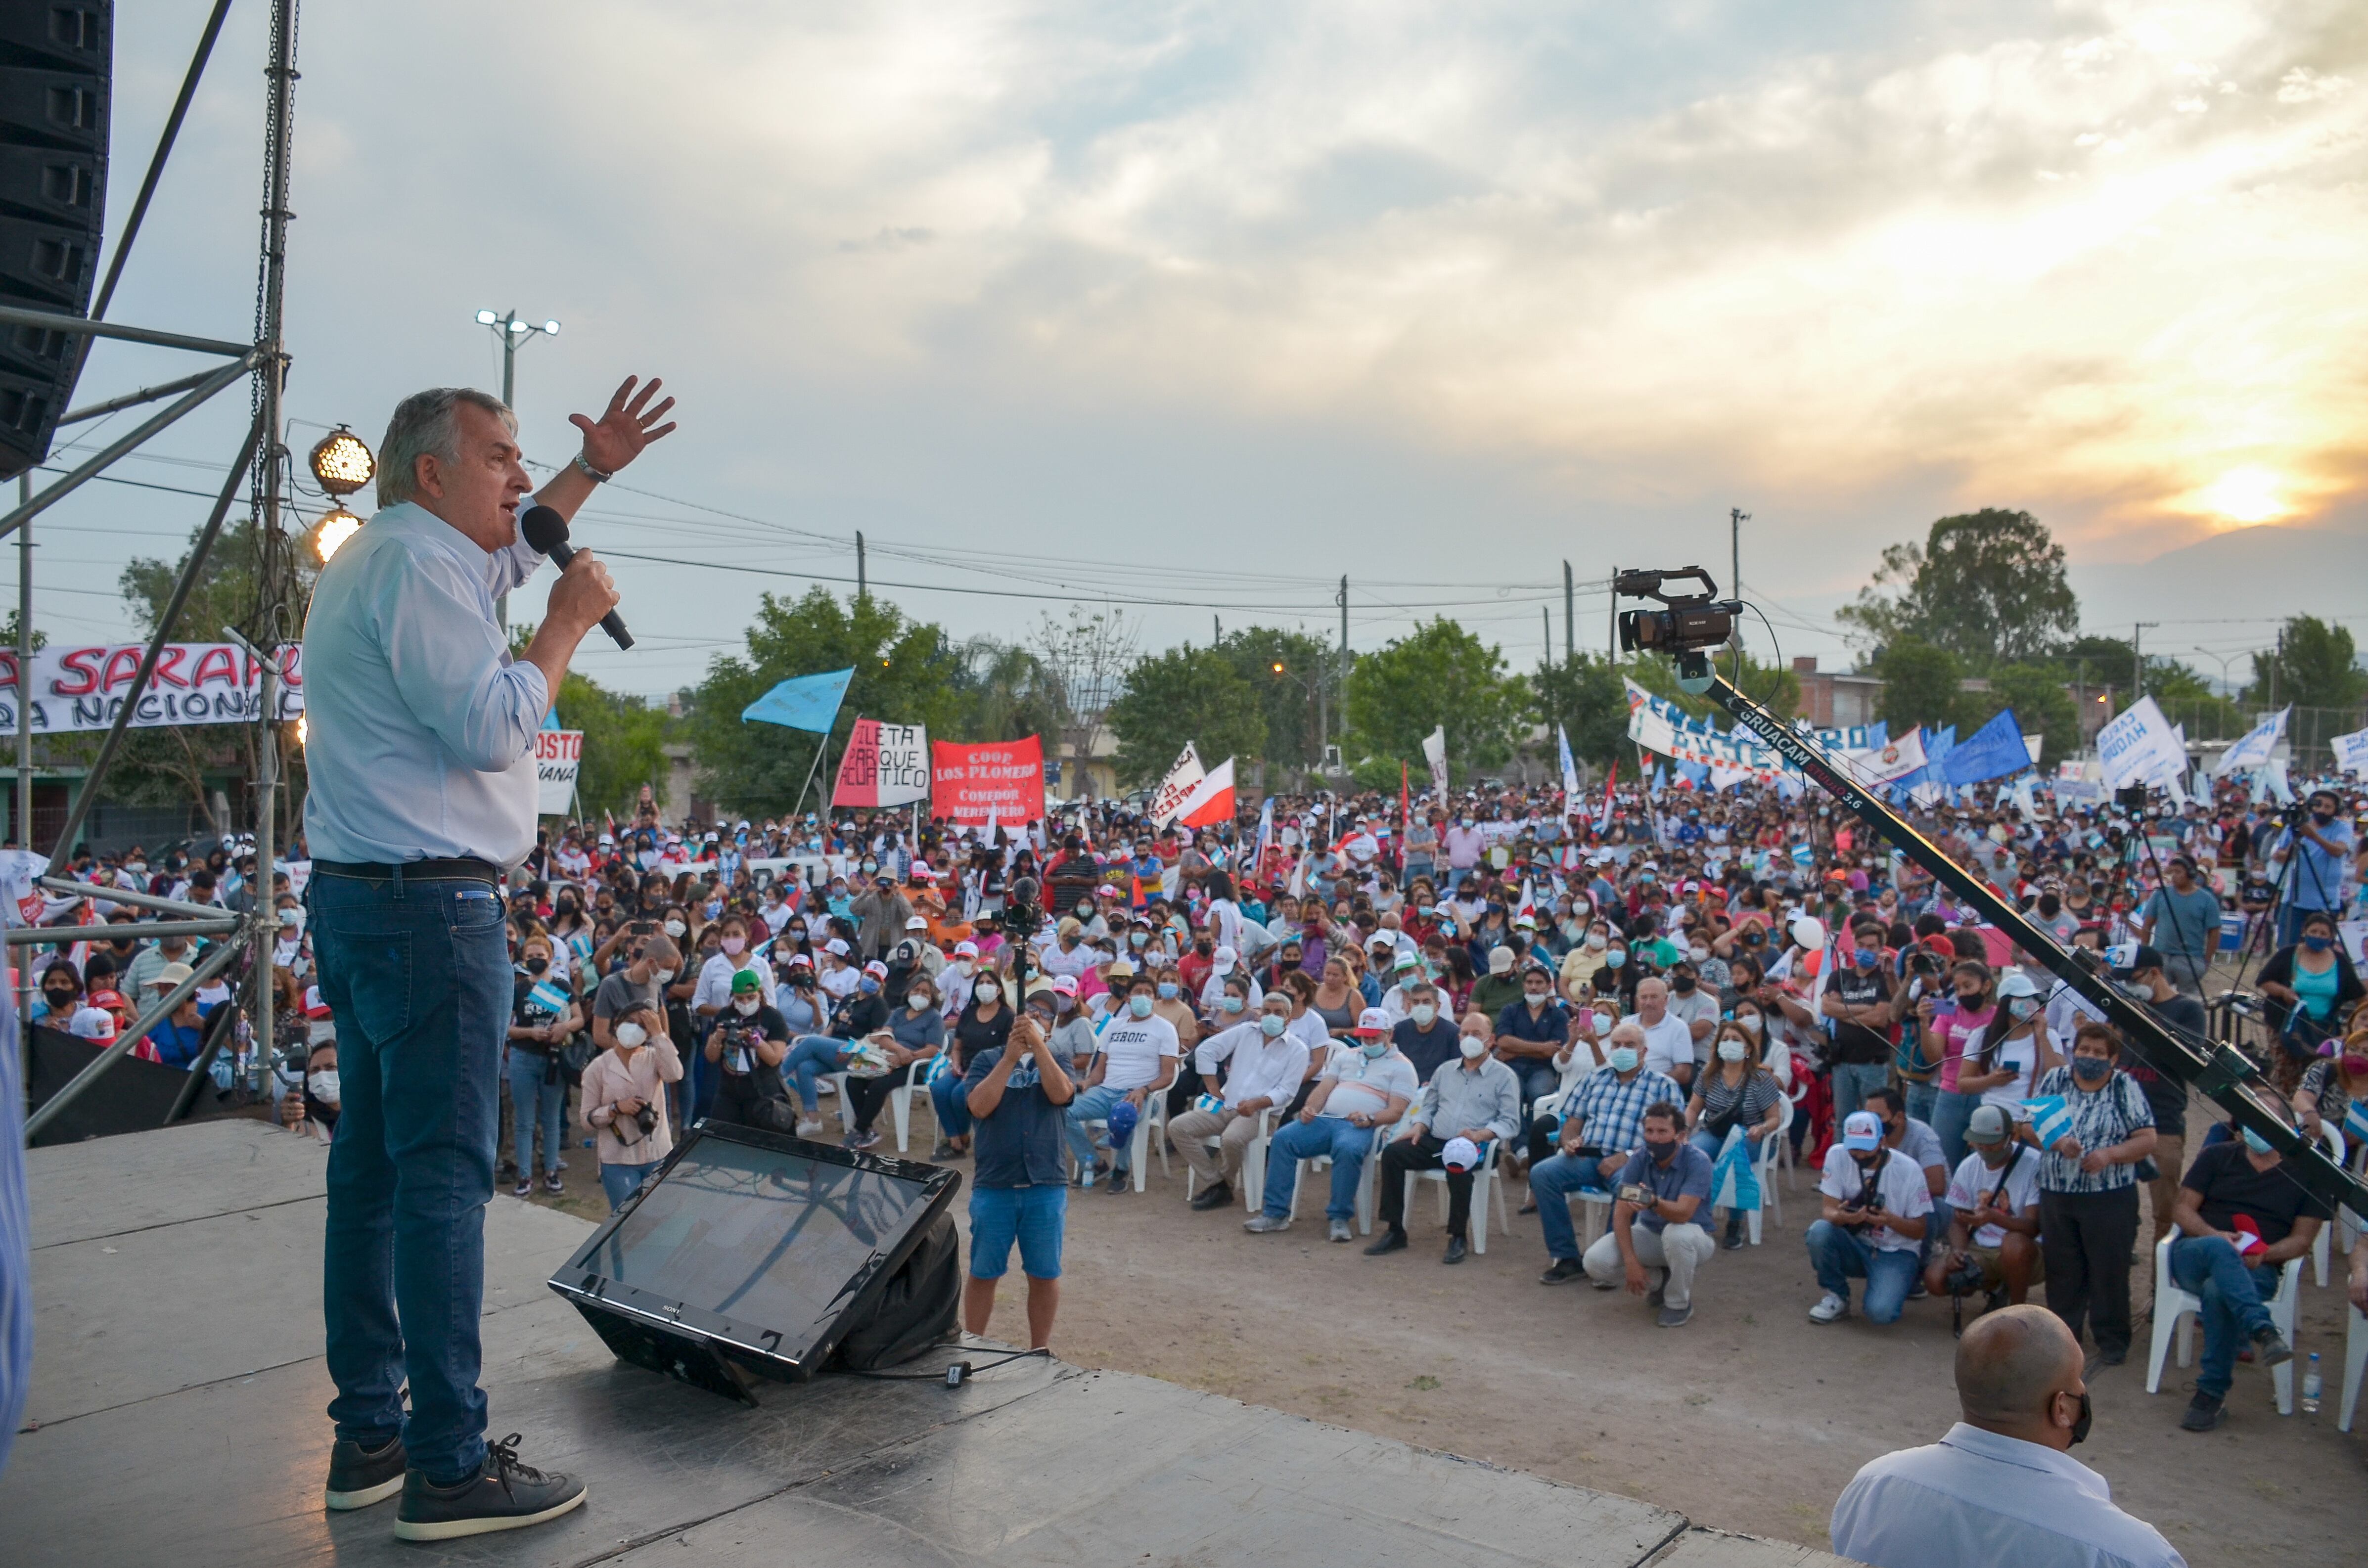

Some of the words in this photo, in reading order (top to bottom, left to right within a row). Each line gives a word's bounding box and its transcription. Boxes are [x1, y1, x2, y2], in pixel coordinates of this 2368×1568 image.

[857, 725, 913, 746] ILETA
[1740, 711, 1812, 766] GRUACAM
[1842, 792, 1863, 809] 3.6
[936, 767, 965, 782] LOS
[662, 1305, 682, 1314] SONY
